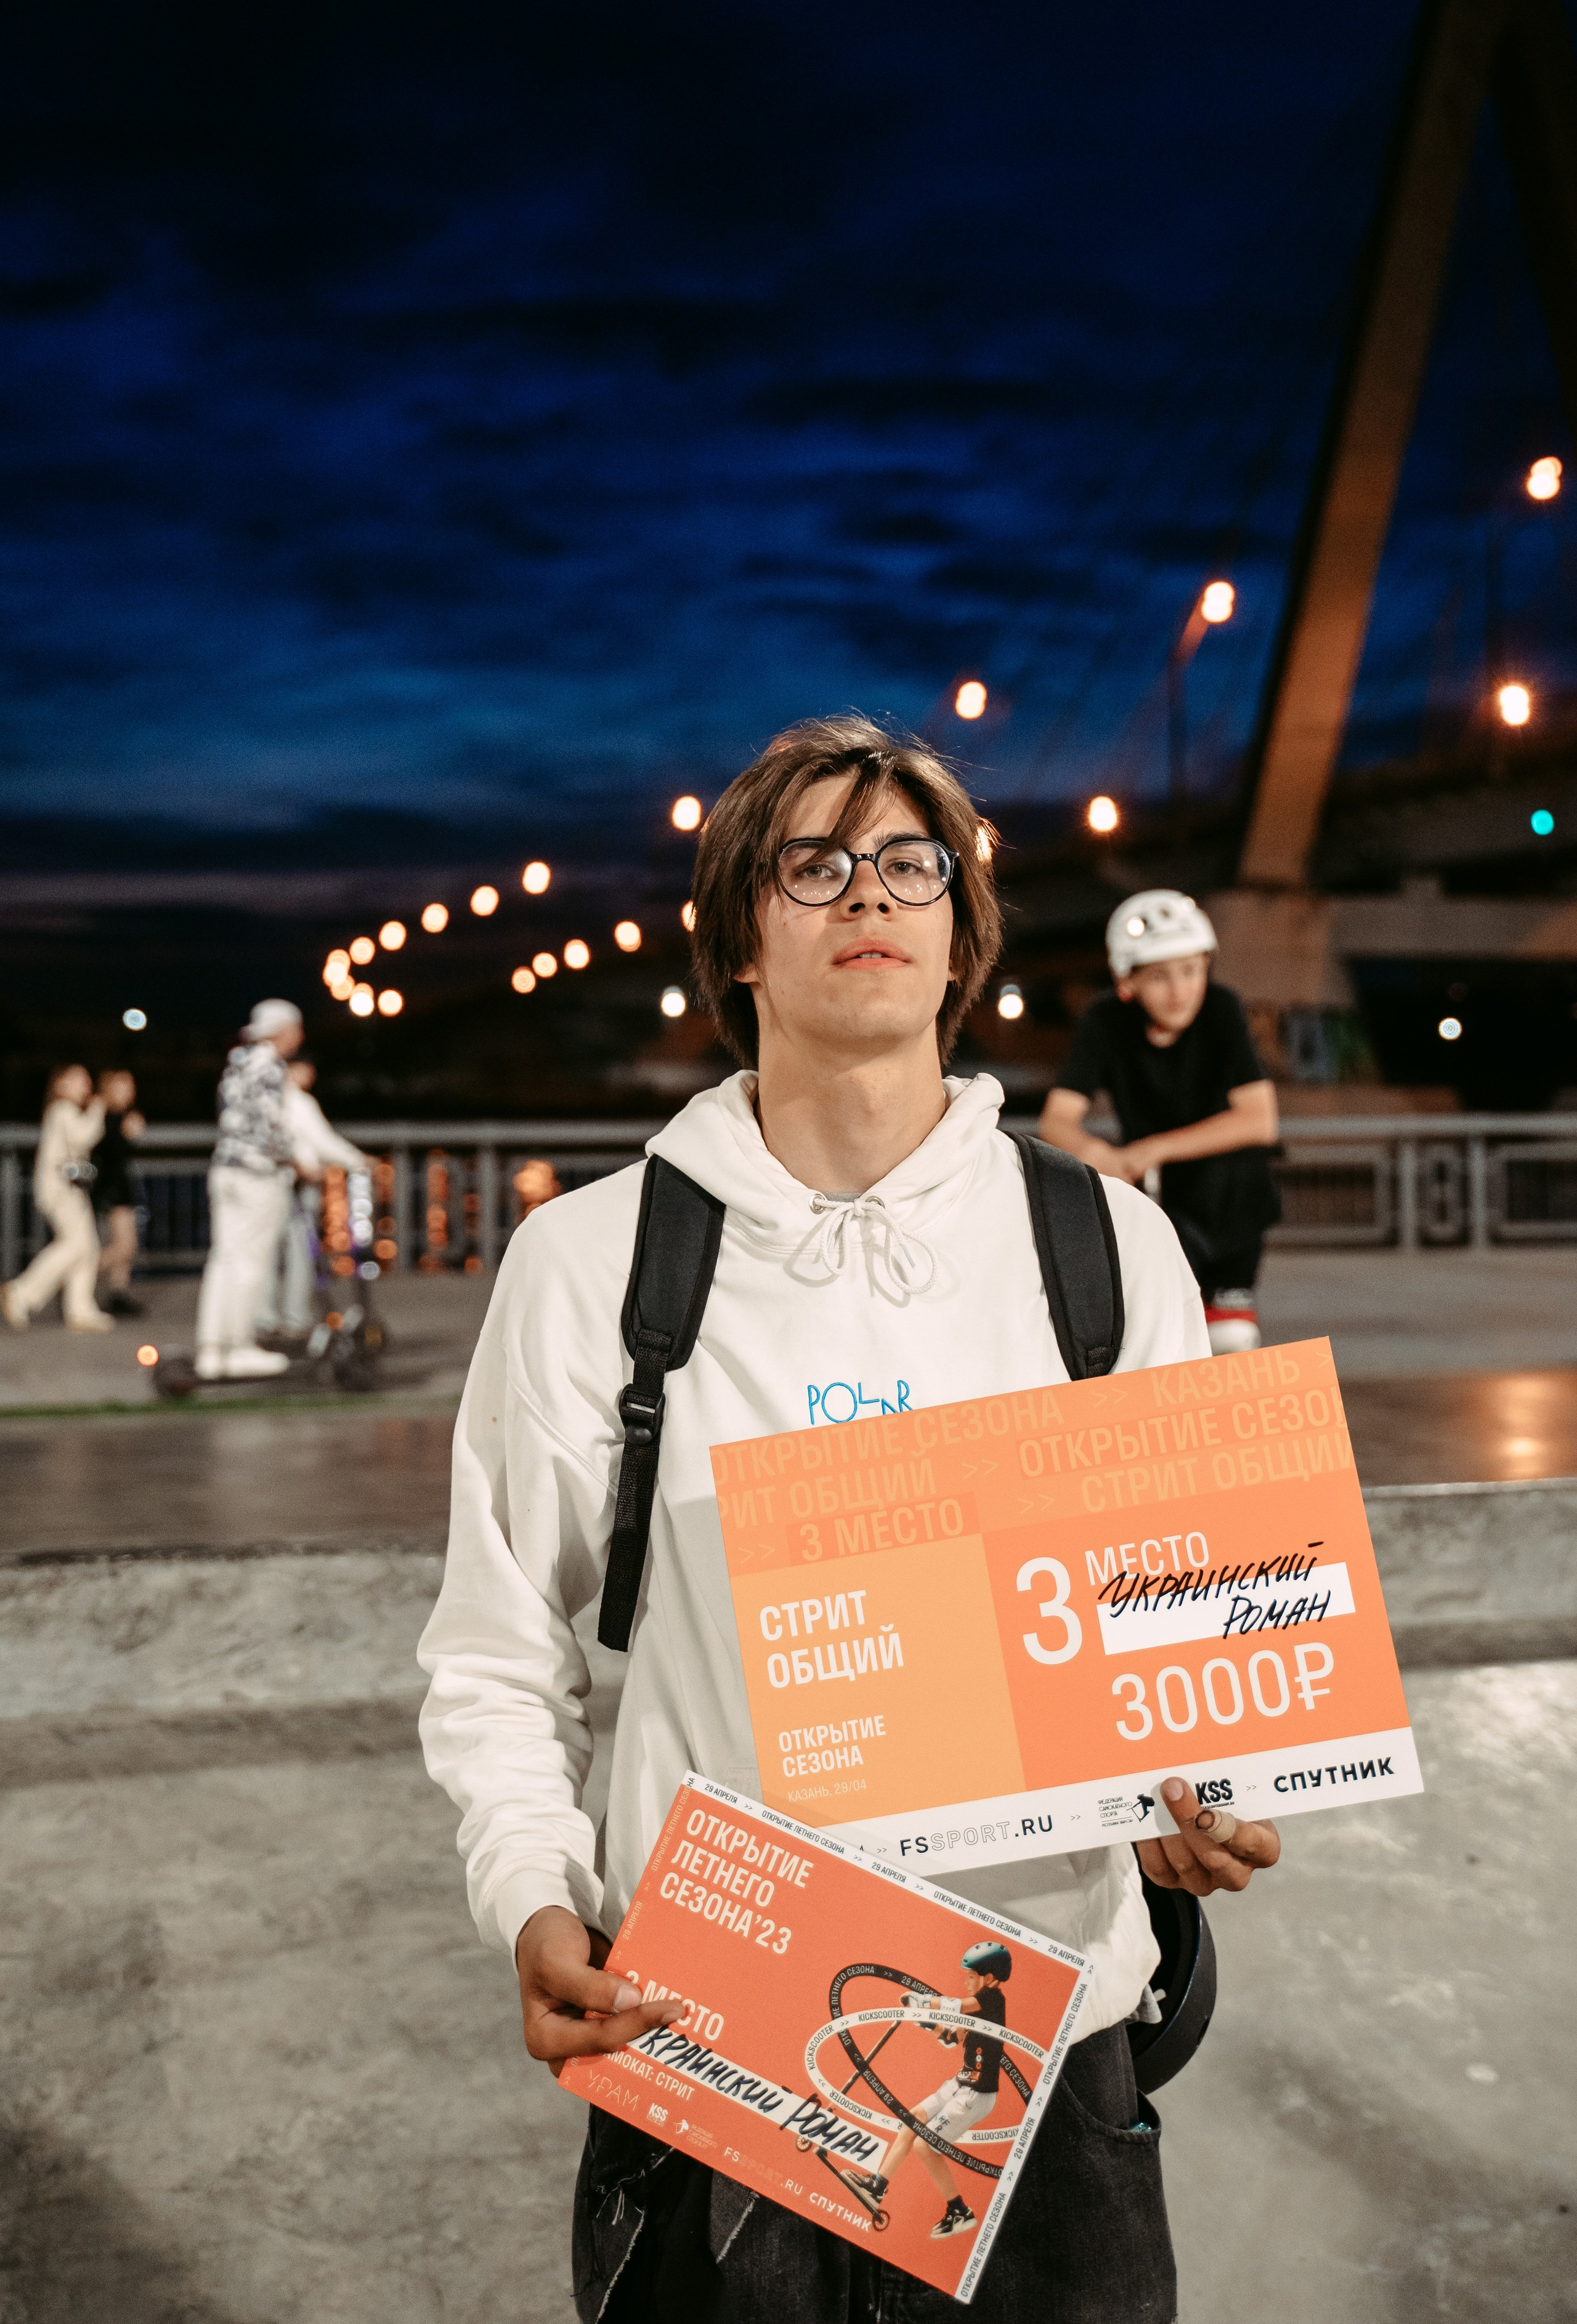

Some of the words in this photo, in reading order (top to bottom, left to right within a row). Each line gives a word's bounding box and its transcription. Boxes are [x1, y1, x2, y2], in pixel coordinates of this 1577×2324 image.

[914, 1390, 1064, 1457] СЕЗОНА
[1150, 1350, 1301, 1408] КАЗАНЬ
[789, 1449, 937, 1518] ОБЩИЙ
[1019, 1407, 1222, 1478] ОТКРЫТИЕ
[801, 1524, 824, 1561] 3
[833, 1499, 965, 1557] МЕСТО
[1081, 1457, 1199, 1514] СТРИТ
[1016, 1557, 1082, 1664] 3
[1085, 1531, 1209, 1585] МЕСТО
[1098, 1541, 1324, 1617] УКРАИНСКИЙ
[759, 1589, 867, 1641] СТРИТ
[1223, 1590, 1331, 1639] РОМАН
[767, 1624, 904, 1688] ОБЩИЙ
[1111, 1642, 1334, 1741] 3000₽
[779, 1715, 886, 1752] ОТКРЫТИЕ
[782, 1745, 864, 1778] СЕЗОНА
[1273, 1756, 1395, 1792] СПУТНИК
[788, 1784, 832, 1802] КАЗАНЬ,
[834, 1779, 867, 1795] 29/04
[1195, 1778, 1233, 1805] KSS
[623, 1929, 631, 1940] 29
[628, 1901, 643, 1929] АПРЕЛЯ
[651, 1835, 670, 1871] ОТКРЫТИЕ
[667, 1805, 683, 1835] ЛЕТНЕГО
[679, 1776, 695, 1805] СЕЗОНА
[686, 1809, 814, 1888] ОТКРЫТИЕ
[899, 1815, 1053, 1856] FSSPORT.RU
[671, 1839, 775, 1908] ЛЕТНЕГО
[705, 1784, 714, 1793] 29
[713, 1788, 738, 1804] АПРЕЛЯ
[761, 1810, 793, 1831] ОТКРЫТИЕ
[793, 1824, 820, 1843] ЛЕТНЕГО
[821, 1838, 845, 1855] СЕЗОНА
[872, 1861, 882, 1871] 29
[881, 1866, 907, 1883] АПРЕЛЯ
[933, 1890, 968, 1911] ОТКРЫТИЕ
[967, 1907, 995, 1925] ЛЕТНЕГО
[995, 1920, 1021, 1937] СЕЗОНА
[1048, 1945, 1058, 1954] 29
[1057, 1949, 1085, 1967] АПРЕЛЯ
[660, 1872, 792, 1954] СЕЗОНА'23
[831, 1974, 846, 2004] ЛЕТНЕГО
[846, 1966, 874, 1976] СЕЗОНА
[901, 1975, 911, 1985] 29
[806, 2024, 834, 2070] KICKSCOOTER
[858, 2009, 904, 2022] KICKSCOOTER
[929, 2012, 976, 2027] KICKSCOOTER
[999, 2028, 1044, 2059] KICKSCOOTER
[639, 2023, 793, 2113] КРАИНСКИЙ
[779, 2093, 879, 2162] РОМАН
[655, 2072, 695, 2101] СТРИТ
[830, 2089, 872, 2120] KICKSCOOTER
[863, 2070, 885, 2095] АПРЕЛЯ
[883, 2094, 893, 2104] 29
[1009, 2069, 1030, 2098] СЕЗОНА
[648, 2102, 669, 2122] KSS
[913, 2121, 938, 2144] СЕЗОНА
[938, 2140, 967, 2164] ЛЕТНЕГО
[960, 2256, 981, 2298] ОТКРЫТИЕ
[976, 2223, 994, 2257] ЛЕТНЕГО
[989, 2192, 1007, 2223] СЕЗОНА
[1020, 2117, 1036, 2148] АПРЕЛЯ
[1042, 2044, 1063, 2085] ОТКРЫТИЕ
[1058, 2013, 1076, 2044] ЛЕТНЕГО
[1071, 1983, 1088, 2012] СЕЗОНА
[809, 2192, 872, 2232] СПУТНИК
